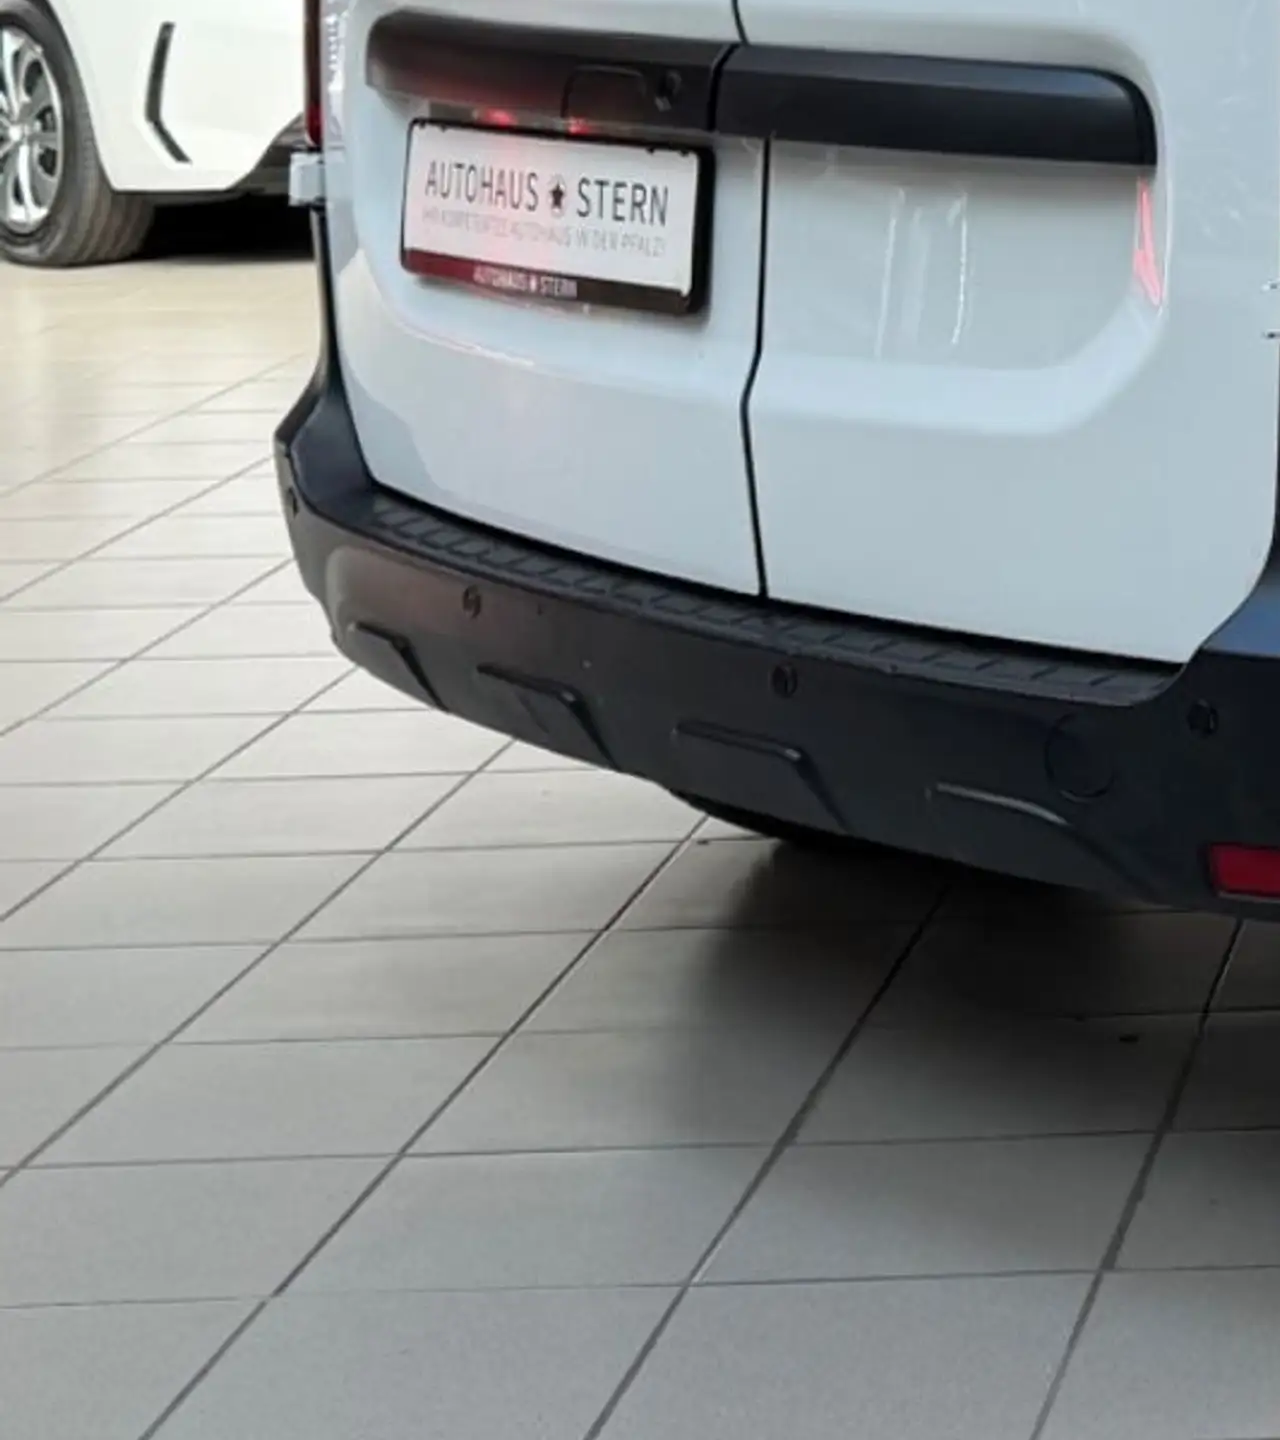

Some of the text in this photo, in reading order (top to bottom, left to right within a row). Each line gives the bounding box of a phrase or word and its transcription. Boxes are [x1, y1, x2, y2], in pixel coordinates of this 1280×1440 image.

[425, 161, 669, 227] AUTOHAUS STERN
[540, 276, 578, 298] STERN
